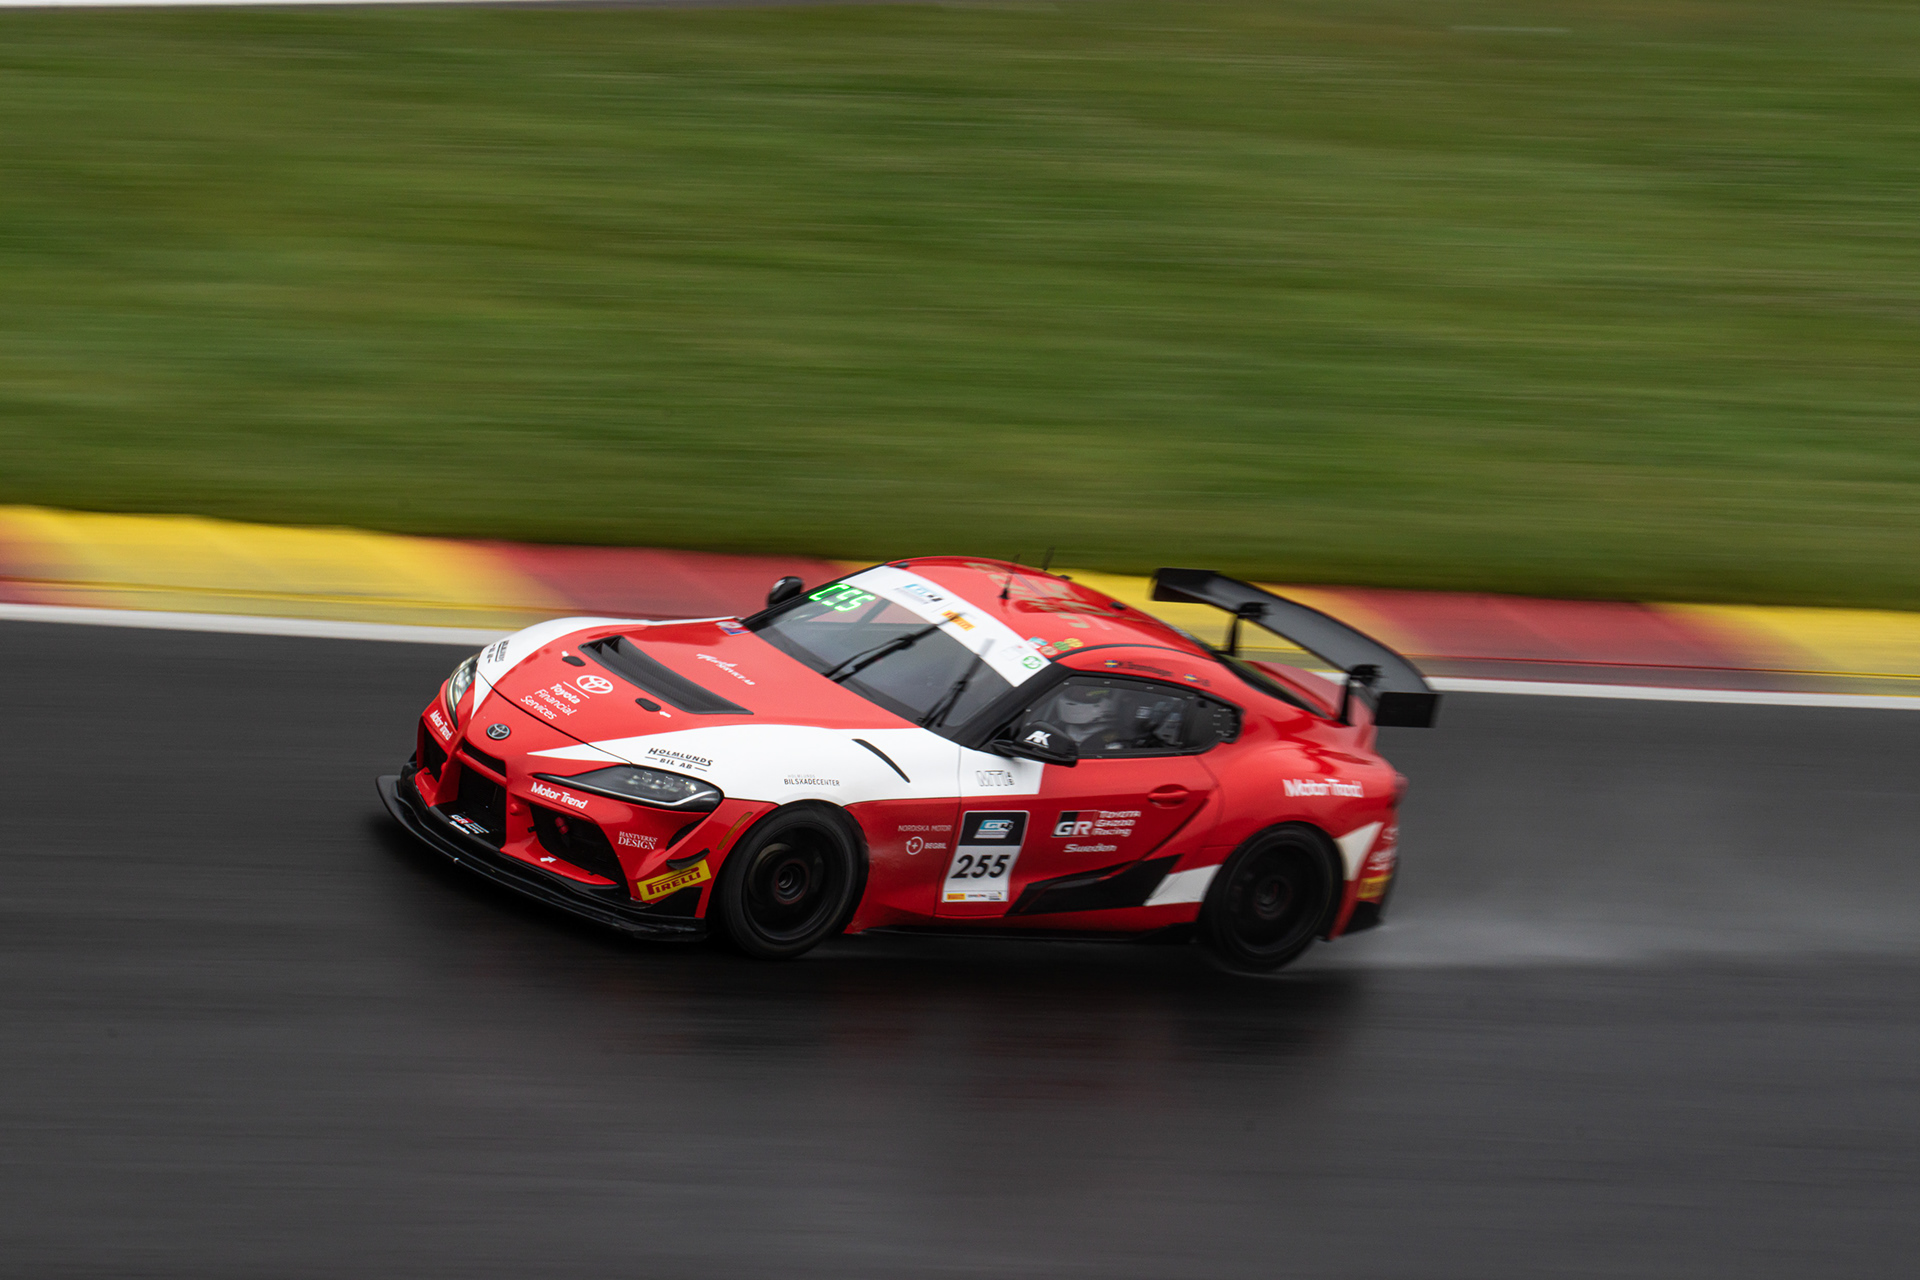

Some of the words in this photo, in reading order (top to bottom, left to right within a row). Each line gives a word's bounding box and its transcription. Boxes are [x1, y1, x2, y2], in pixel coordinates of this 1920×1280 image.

[534, 689, 577, 716] Financial
[550, 683, 581, 704] Toyota
[520, 695, 557, 720] Services
[648, 747, 713, 767] HOLMLUNDS
[659, 758, 675, 766] BIL
[679, 762, 693, 770] AB
[783, 778, 841, 787] BILSKADECENTER
[530, 781, 561, 800] Motor
[560, 791, 588, 809] Trend
[1053, 821, 1093, 836] GR
[618, 836, 655, 850] DESIGN
[1062, 843, 1117, 853] Sweden
[951, 854, 1011, 879] 255
[646, 867, 701, 896] PIRELLI
